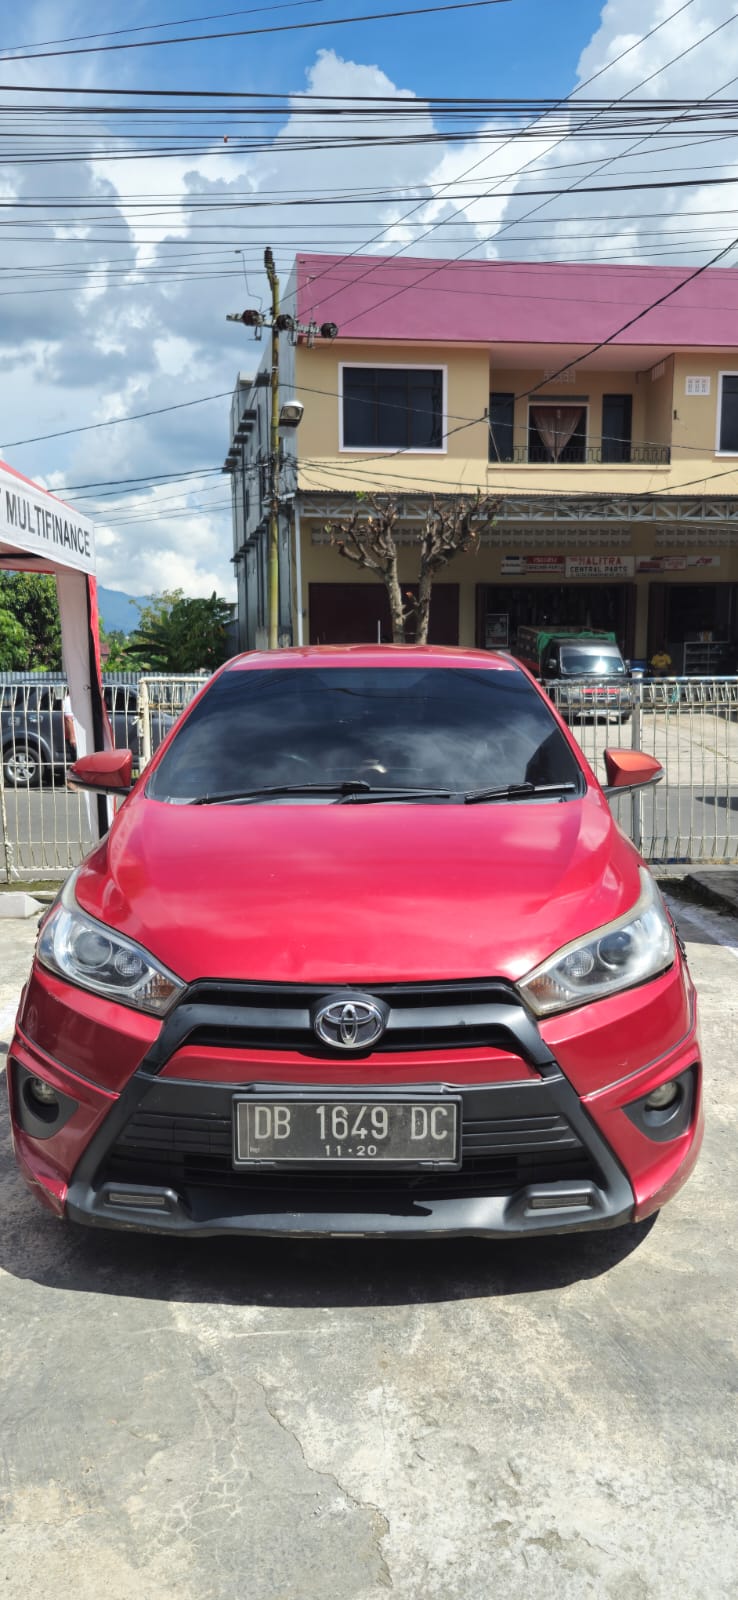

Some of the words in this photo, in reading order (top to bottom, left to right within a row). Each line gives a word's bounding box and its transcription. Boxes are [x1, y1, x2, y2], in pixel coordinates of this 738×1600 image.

[5, 490, 91, 558] MULTIFINANCE
[254, 1106, 292, 1140] DB
[315, 1105, 389, 1140] 1649
[410, 1106, 448, 1140] DC
